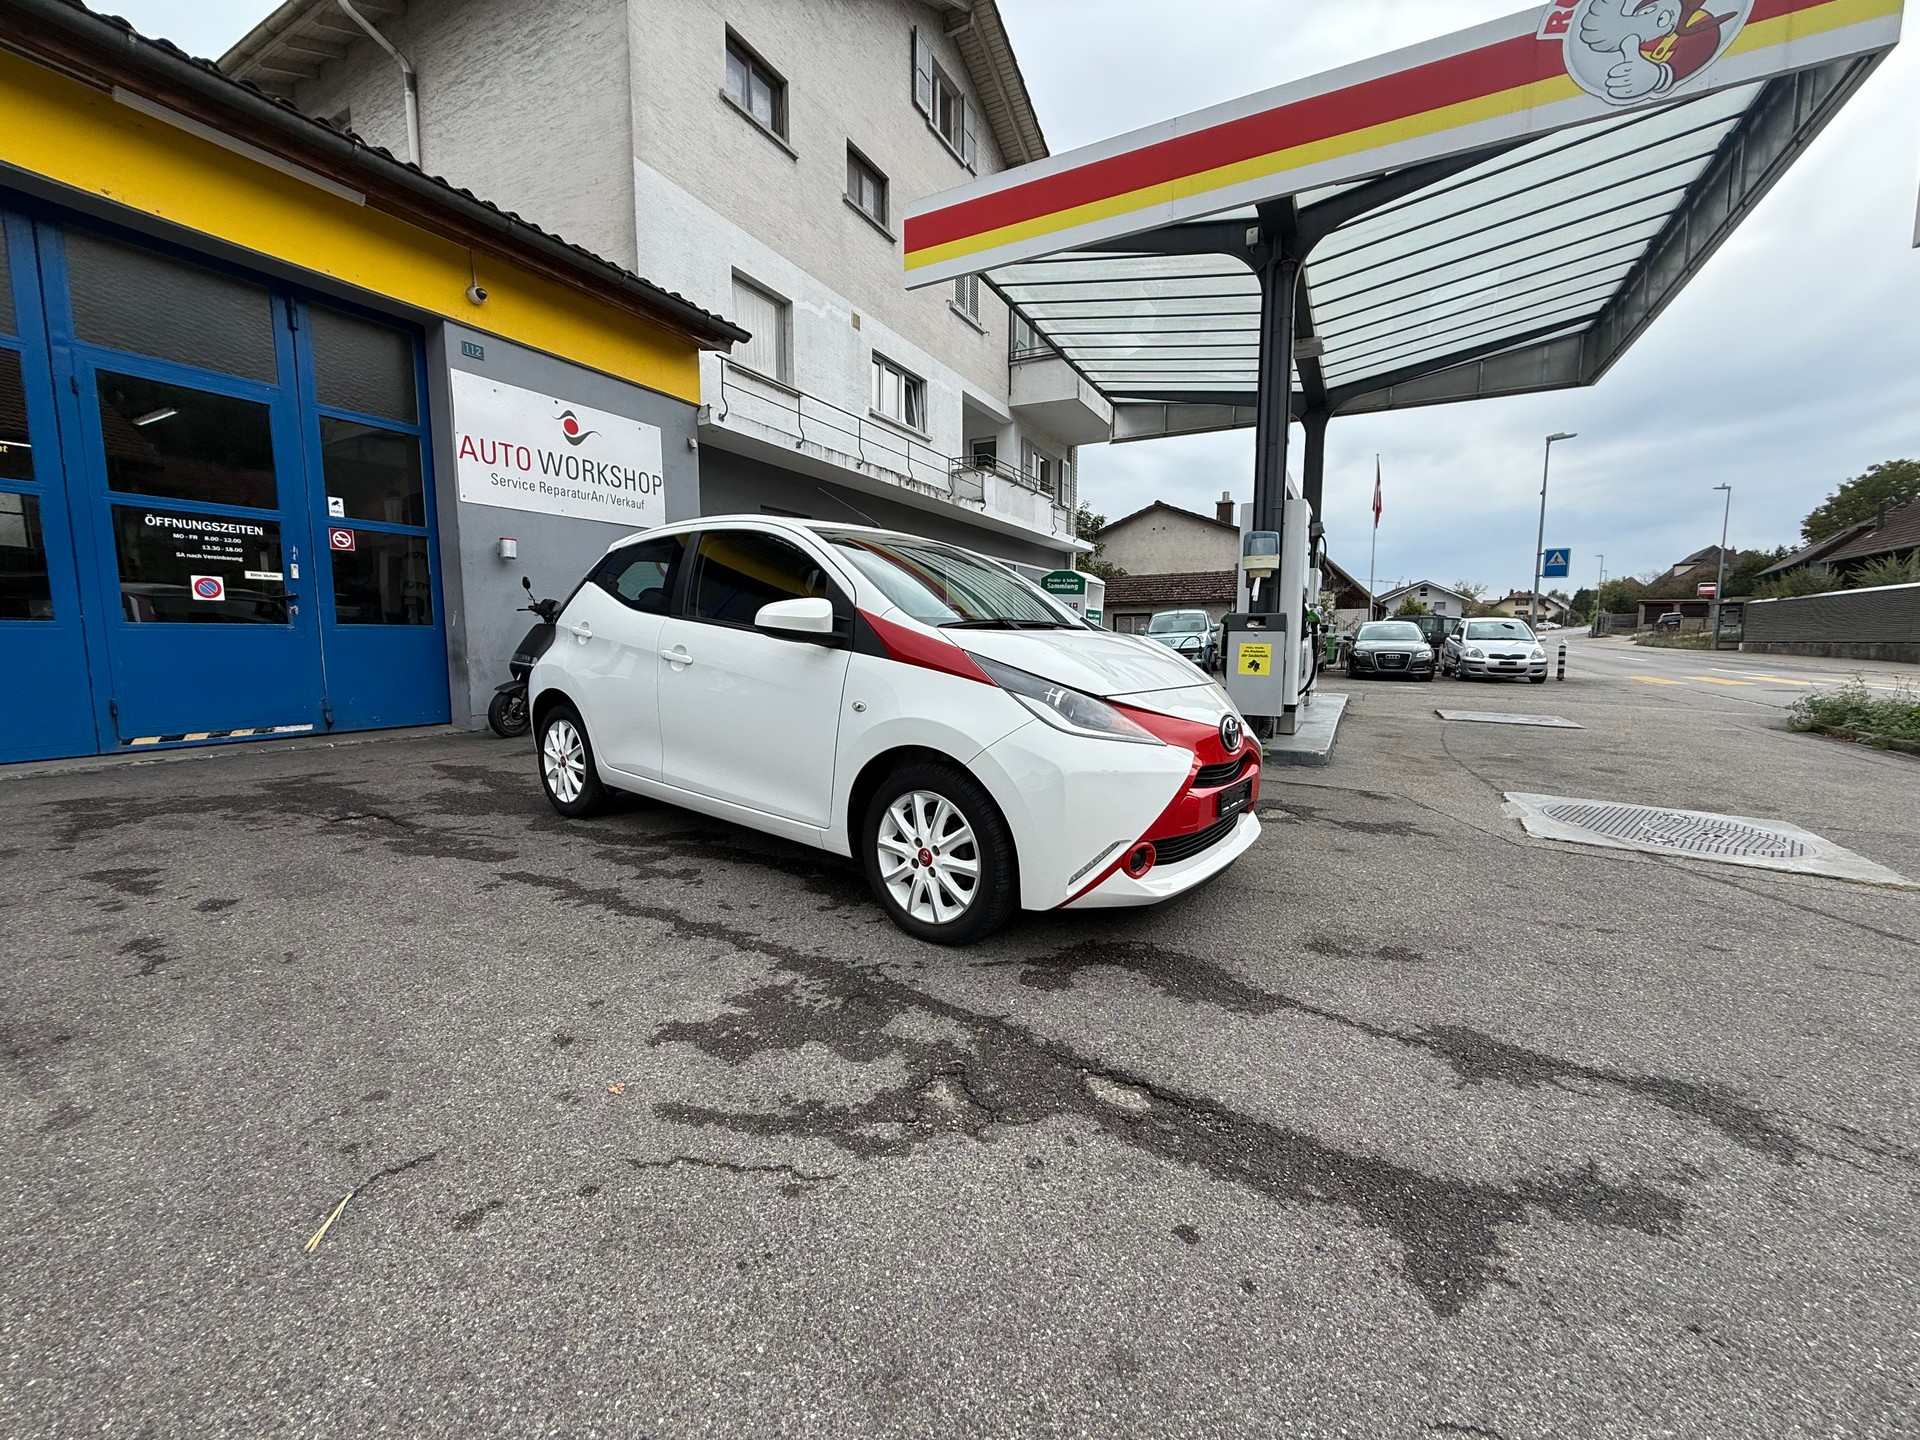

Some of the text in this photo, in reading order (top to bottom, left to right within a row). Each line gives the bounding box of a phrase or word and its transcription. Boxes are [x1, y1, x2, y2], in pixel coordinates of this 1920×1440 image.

[465, 343, 481, 357] 112
[459, 435, 662, 496] AUTO WORKSHOP
[491, 473, 536, 492] Service
[144, 513, 264, 536] ÖFFNUNGSZEITEN
[203, 554, 243, 562] Vereinbarung
[1047, 583, 1078, 591] Sammlung
